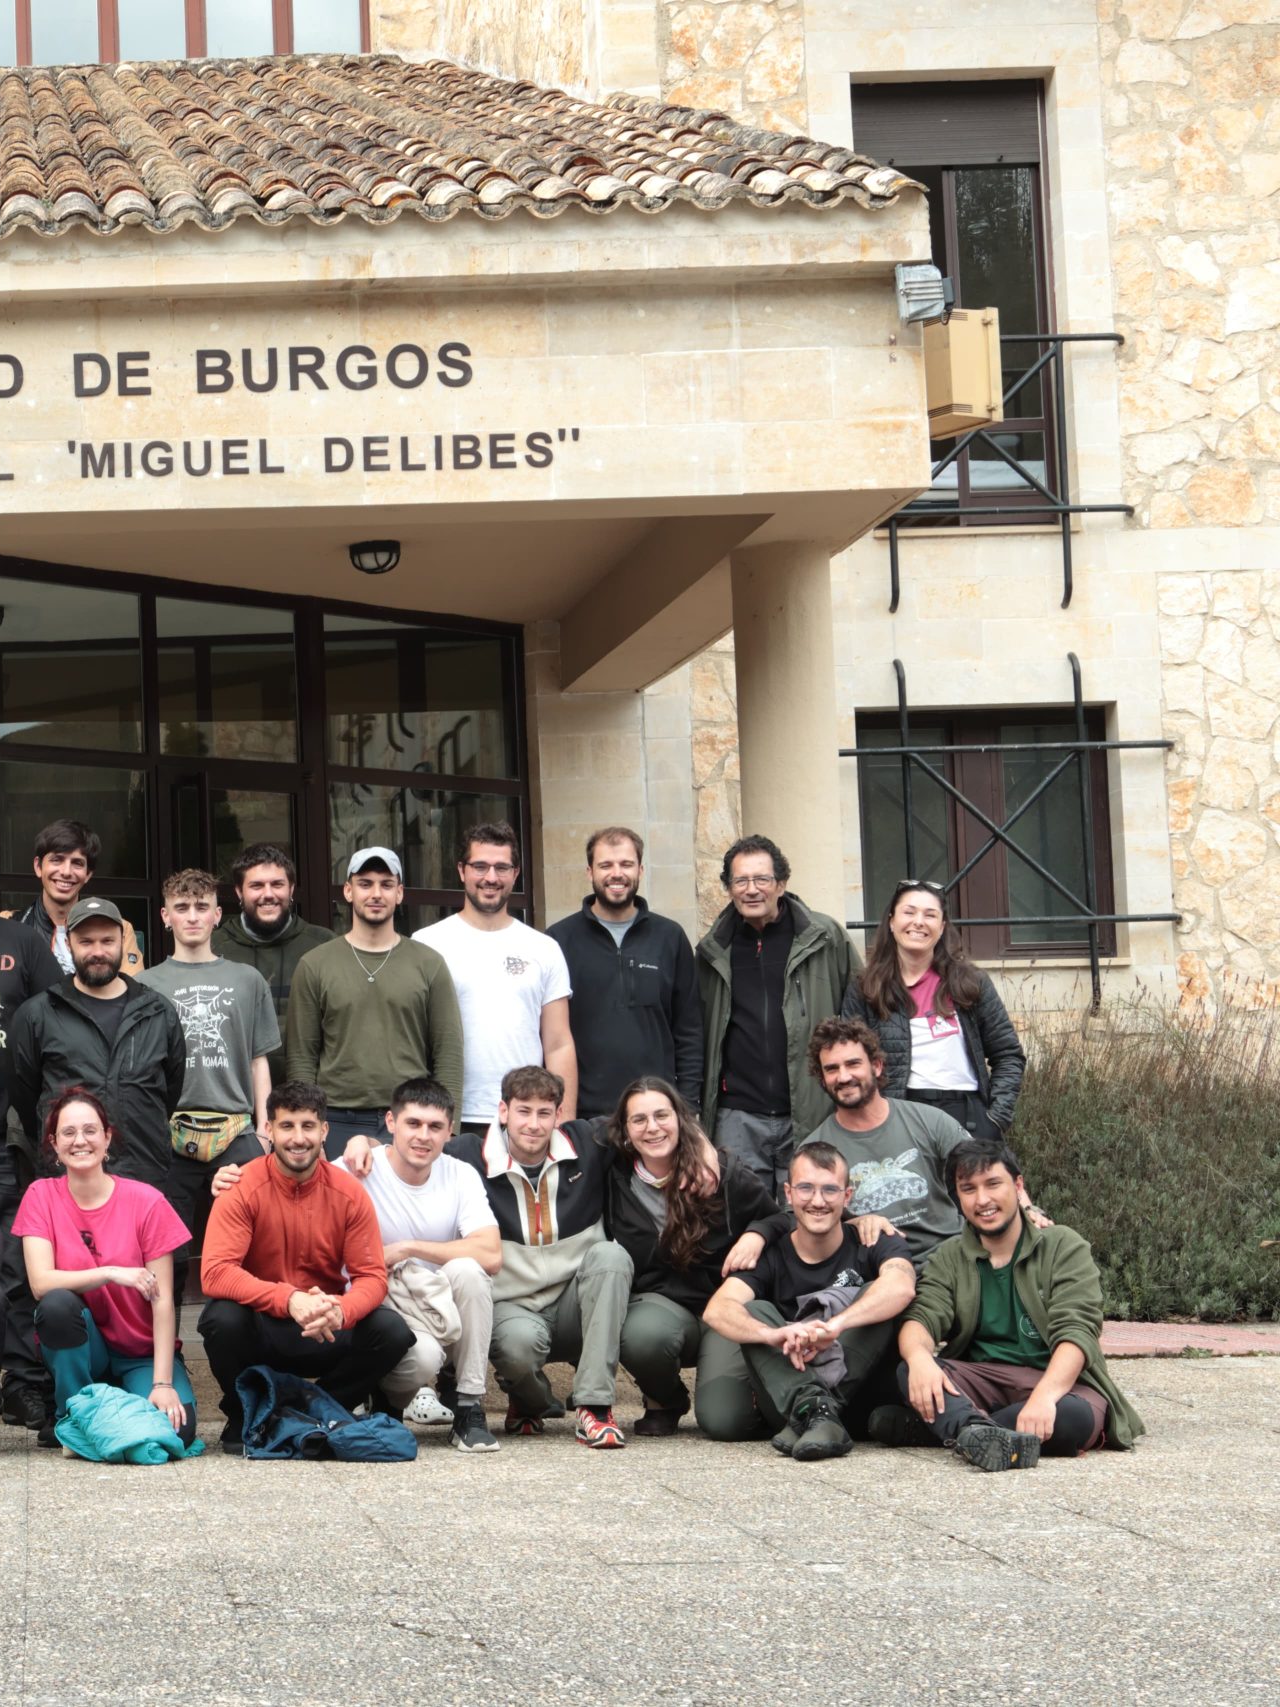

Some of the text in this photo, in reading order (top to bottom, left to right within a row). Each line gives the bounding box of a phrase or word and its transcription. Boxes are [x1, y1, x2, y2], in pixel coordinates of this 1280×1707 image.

[73, 351, 152, 398] DE
[196, 342, 473, 394] BURGOS
[204, 1040, 217, 1049] LOS
